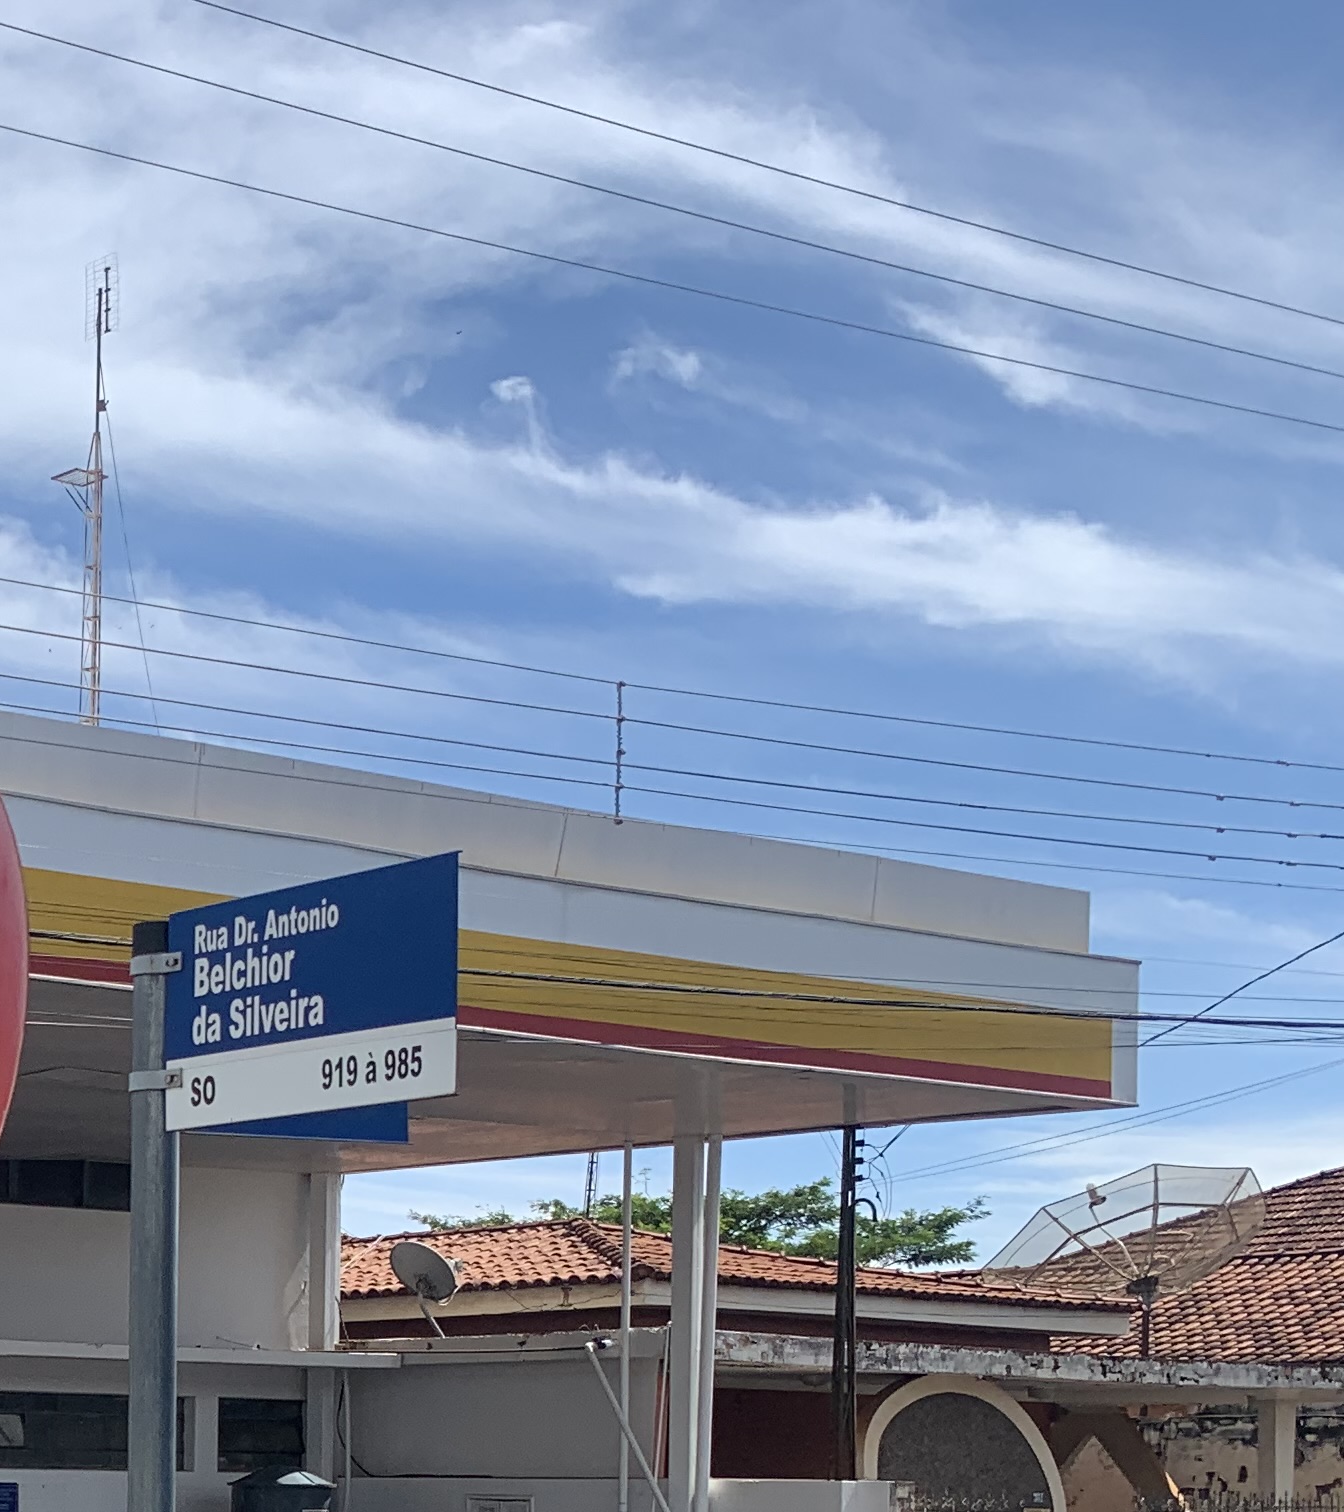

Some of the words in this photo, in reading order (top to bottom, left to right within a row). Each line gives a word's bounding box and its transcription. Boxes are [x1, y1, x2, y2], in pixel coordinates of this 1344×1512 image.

[193, 923, 228, 955] Rua
[233, 915, 259, 947] Dr.
[263, 897, 340, 941] Antonio
[193, 944, 295, 998] Belchior
[192, 1005, 221, 1046] da
[228, 988, 325, 1040] Silveira
[190, 1075, 216, 1107] SO
[321, 1054, 358, 1090] 919
[365, 1052, 377, 1085] à
[384, 1045, 423, 1082] 985
